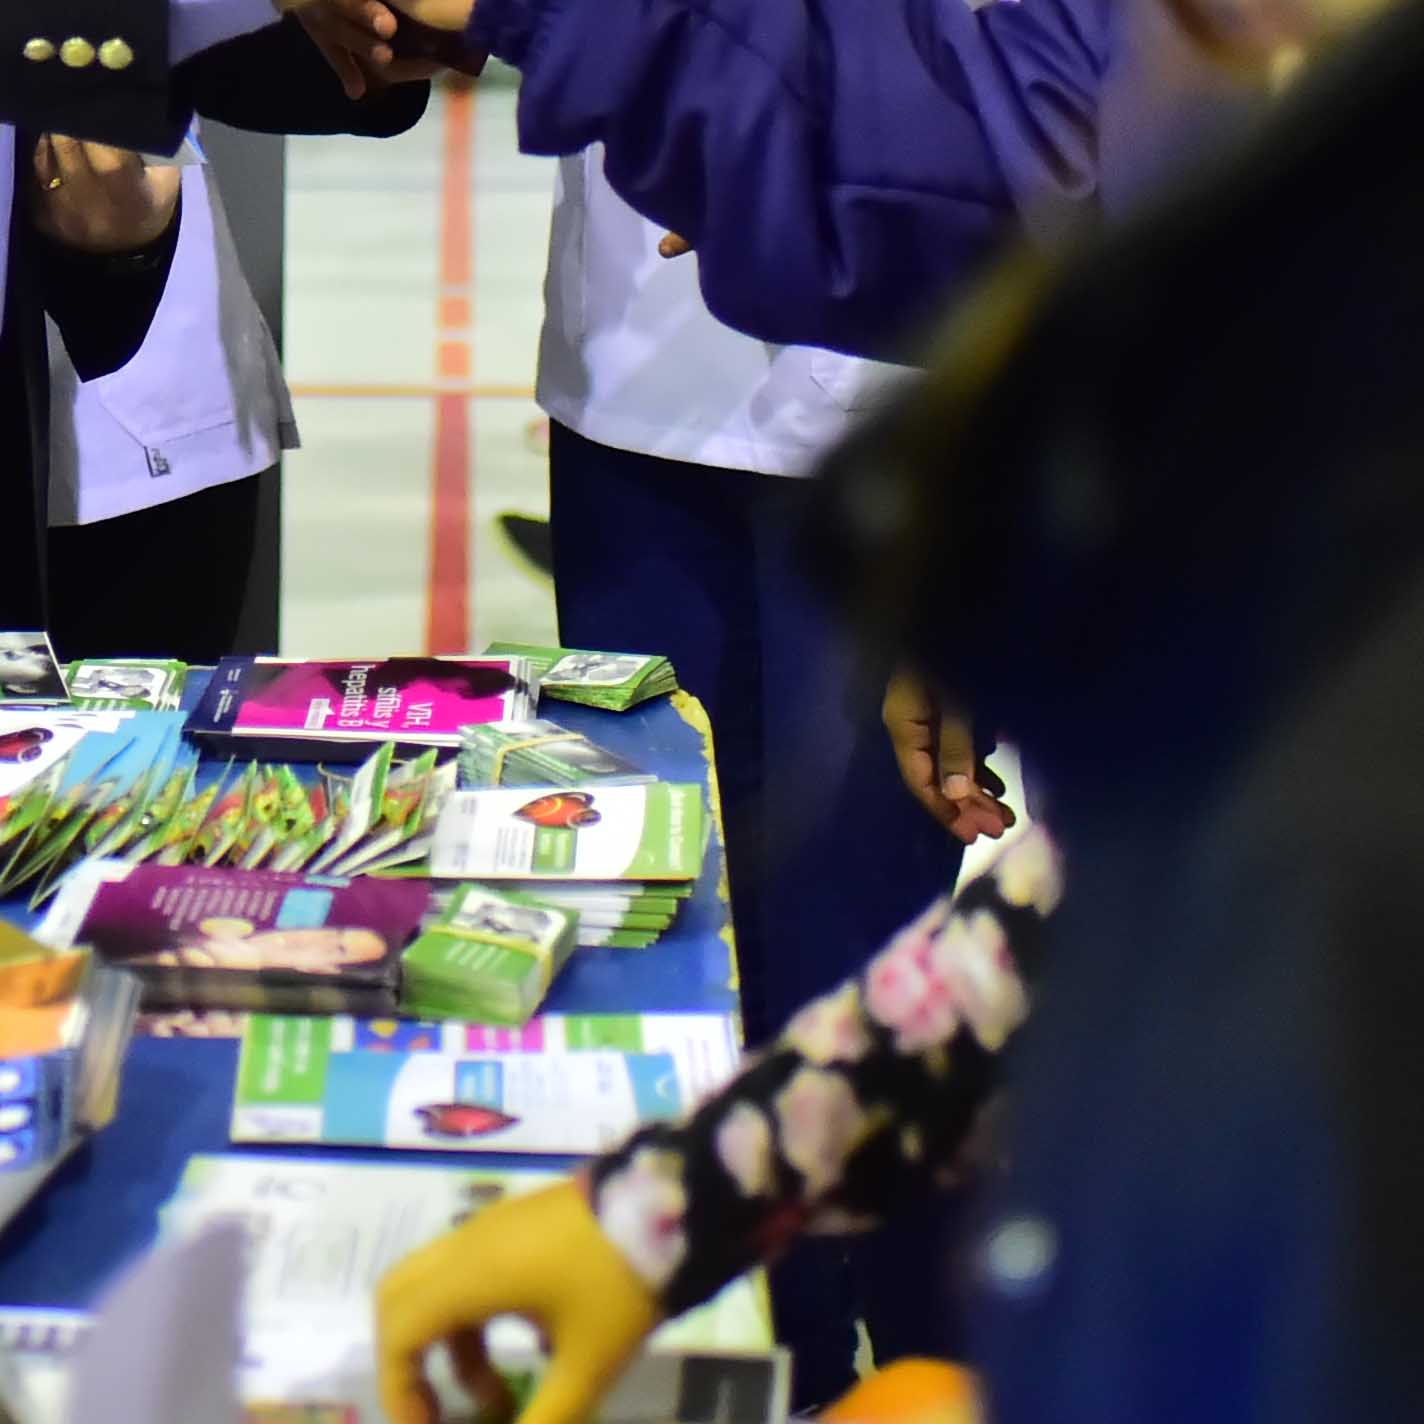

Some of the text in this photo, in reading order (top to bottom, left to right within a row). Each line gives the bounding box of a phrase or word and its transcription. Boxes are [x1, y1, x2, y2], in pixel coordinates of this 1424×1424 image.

[337, 664, 377, 728] hepatitis B
[364, 687, 403, 728] sífilis y
[399, 701, 435, 729] VIH,
